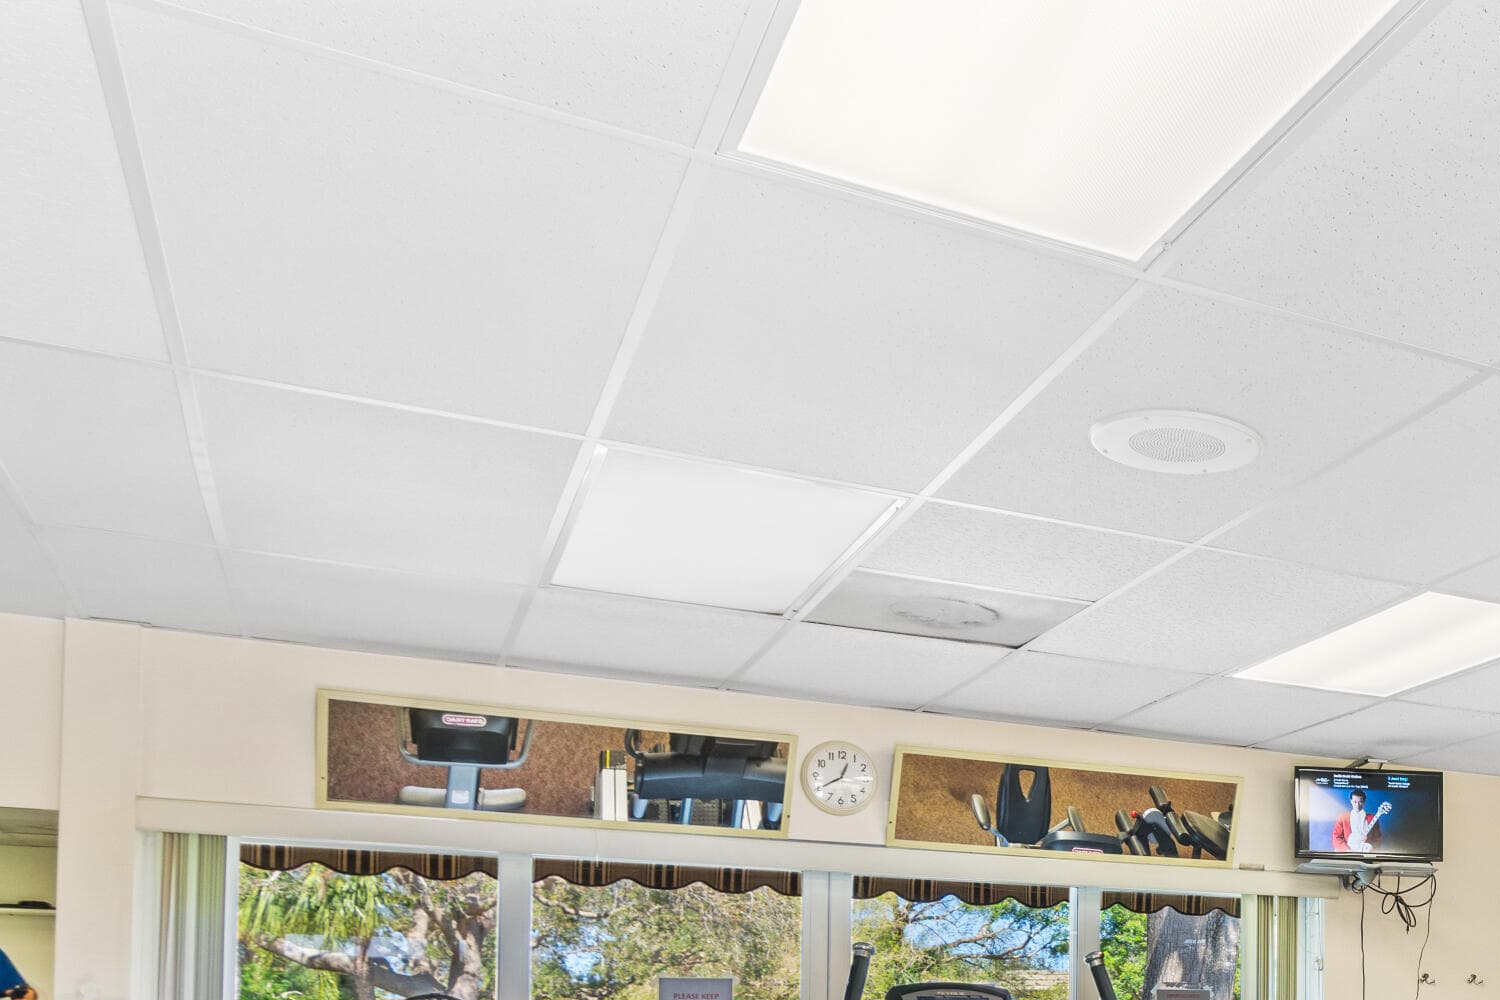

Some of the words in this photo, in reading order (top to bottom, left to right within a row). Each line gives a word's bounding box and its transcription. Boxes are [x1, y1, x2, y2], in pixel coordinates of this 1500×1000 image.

[828, 752, 834, 761] 11
[837, 750, 847, 760] 12
[817, 759, 826, 768] 10
[860, 763, 867, 772] 2
[827, 792, 834, 801] 7
[837, 797, 845, 805] 6
[850, 794, 857, 803] 5
